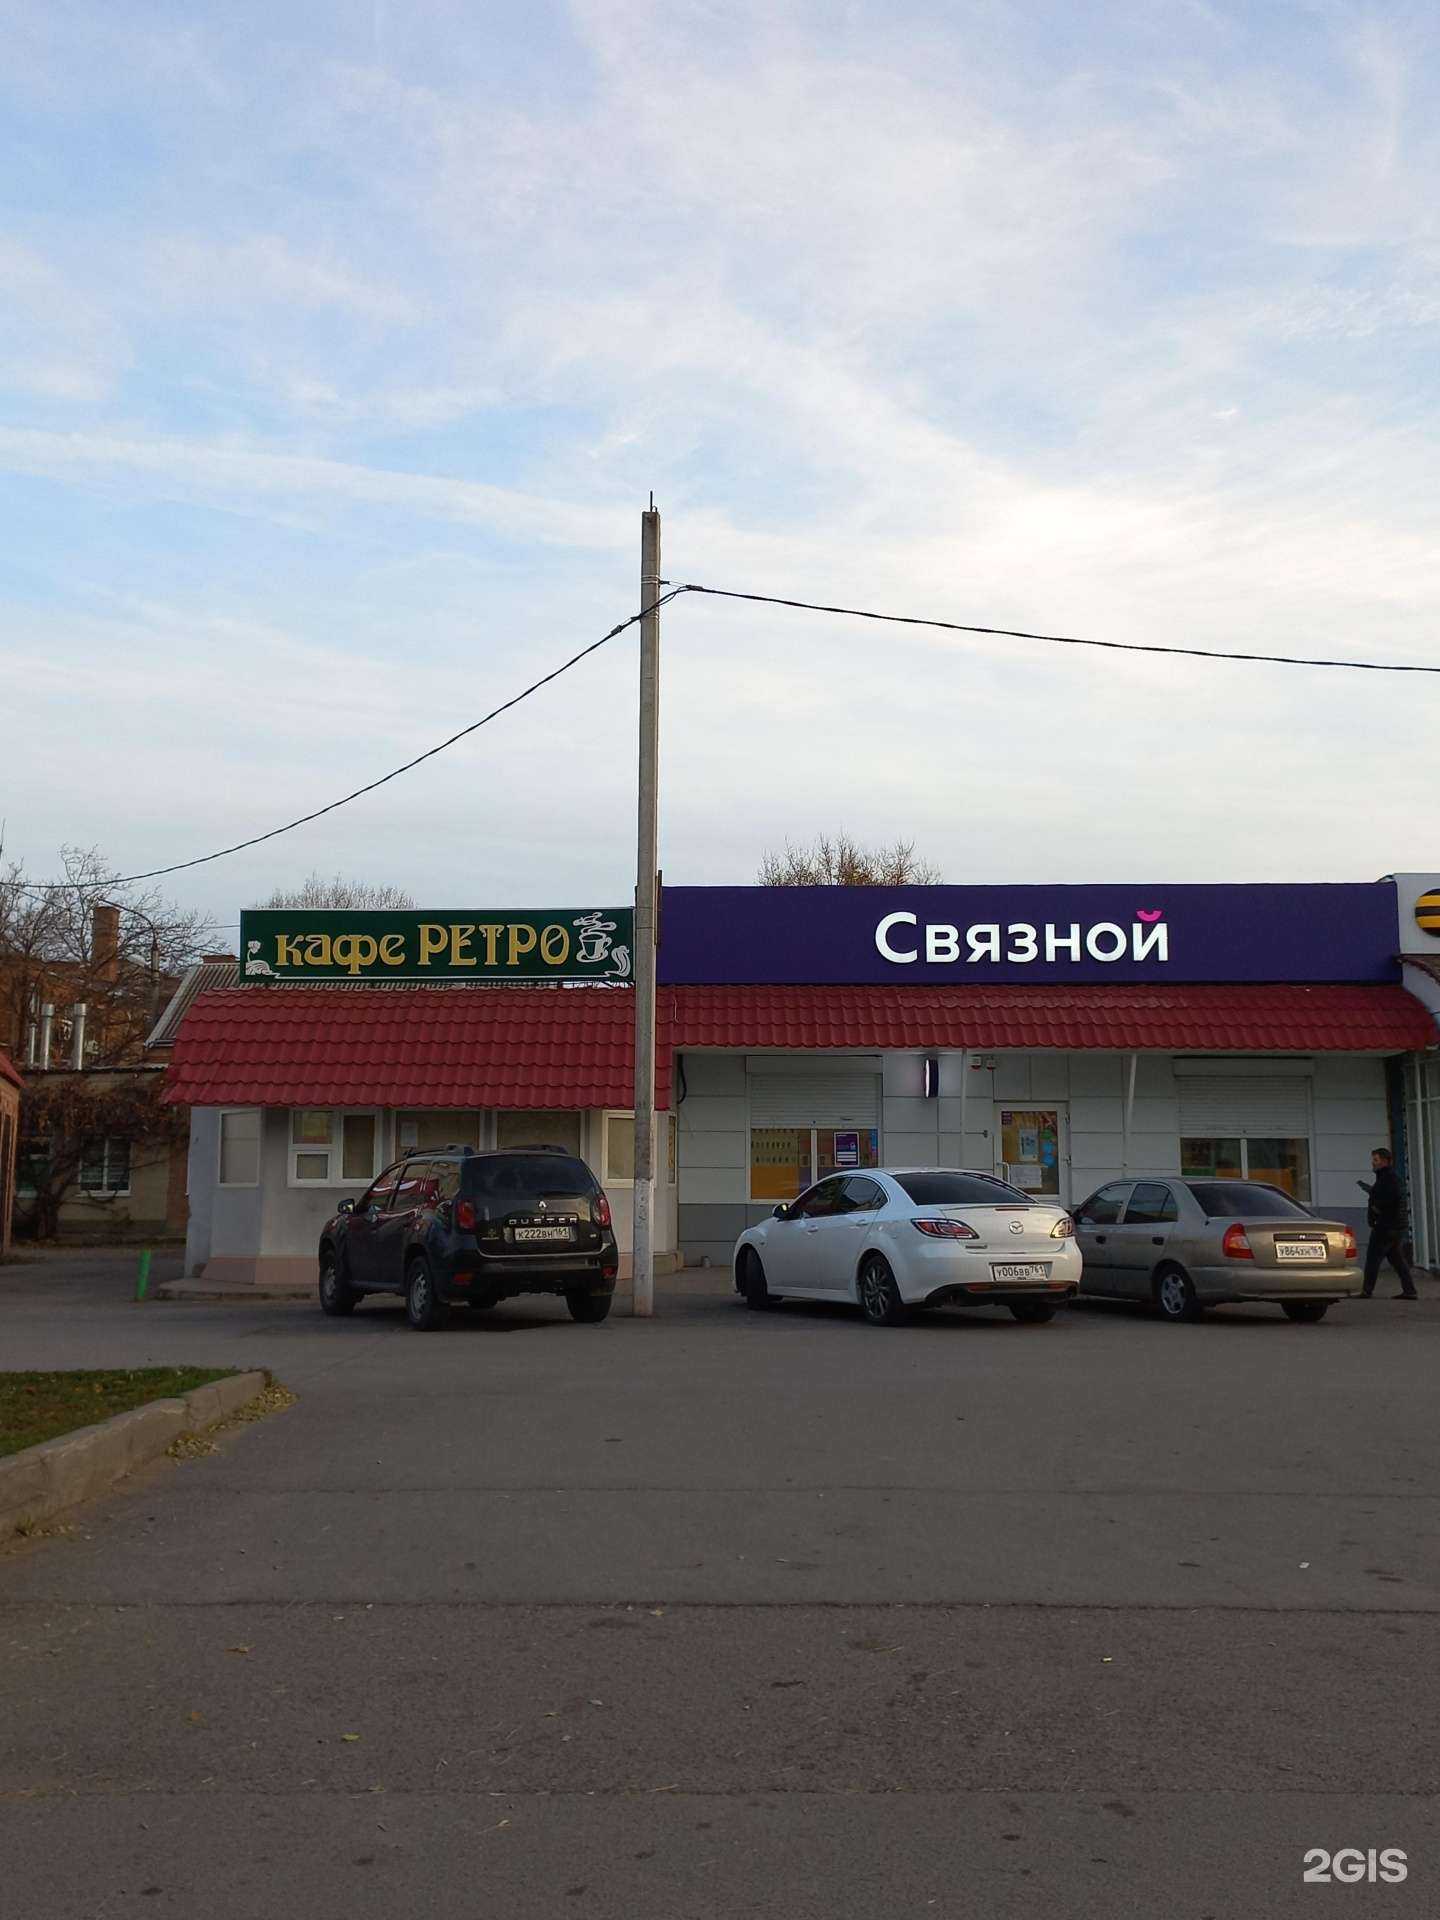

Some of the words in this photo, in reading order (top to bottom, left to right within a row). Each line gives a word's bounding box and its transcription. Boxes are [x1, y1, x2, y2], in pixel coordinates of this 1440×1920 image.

[275, 934, 405, 975] кафе
[417, 924, 569, 965] РЕТРО
[875, 910, 1168, 963] Связной
